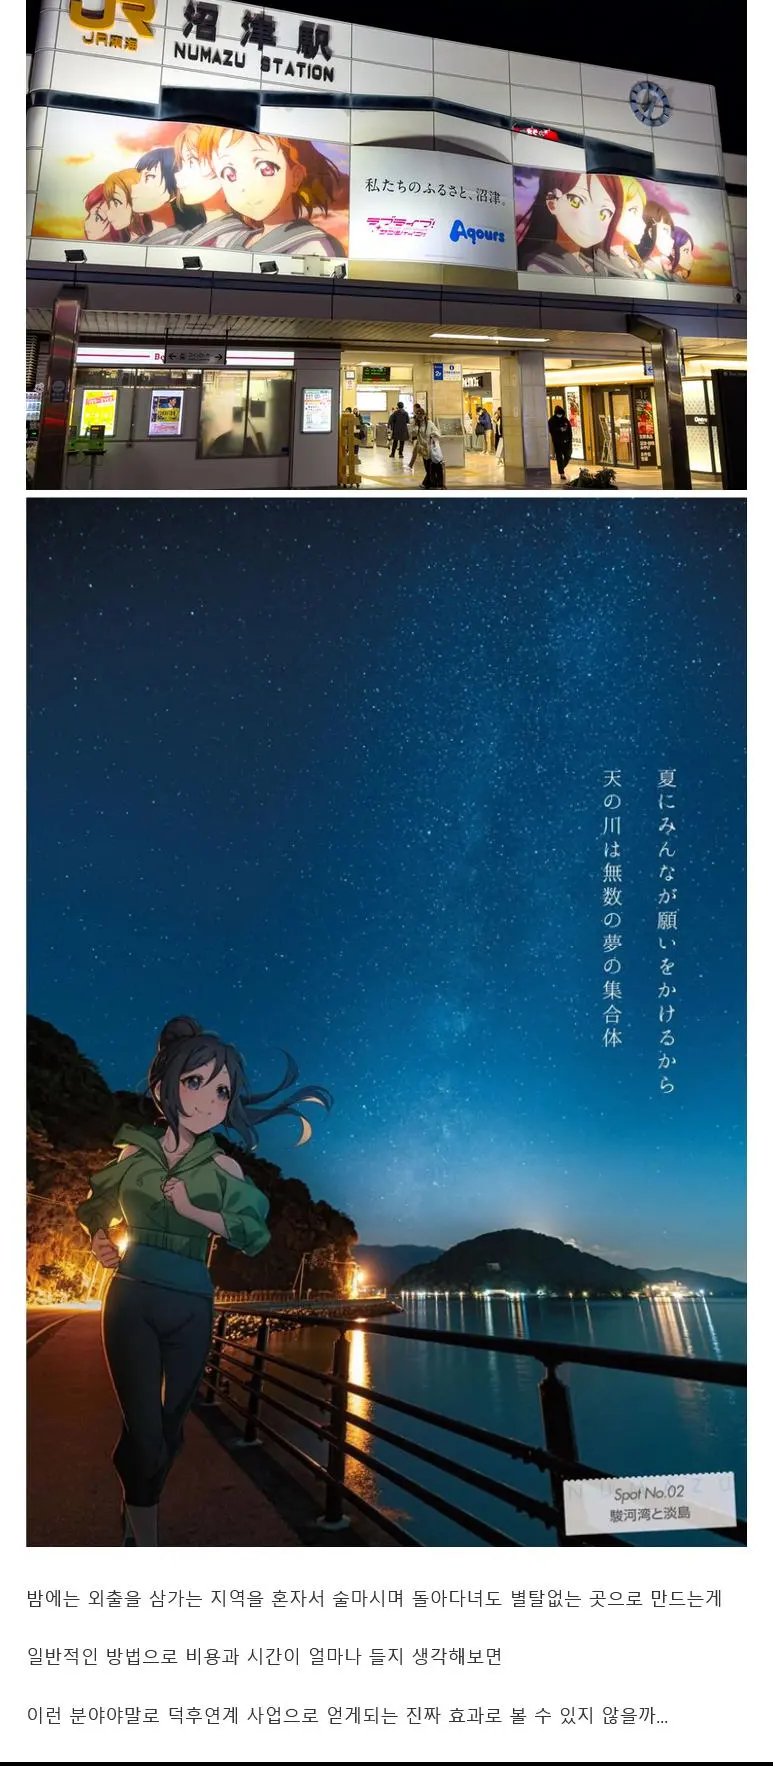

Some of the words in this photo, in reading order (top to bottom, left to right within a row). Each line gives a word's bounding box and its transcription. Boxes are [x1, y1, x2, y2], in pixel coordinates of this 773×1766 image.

[82, 32, 138, 51] JR東海
[173, 41, 246, 68] NUMAZU
[260, 55, 335, 82] STATION
[365, 178, 506, 207] 私たちのふるさと、沼津。
[449, 219, 506, 245] Aqours
